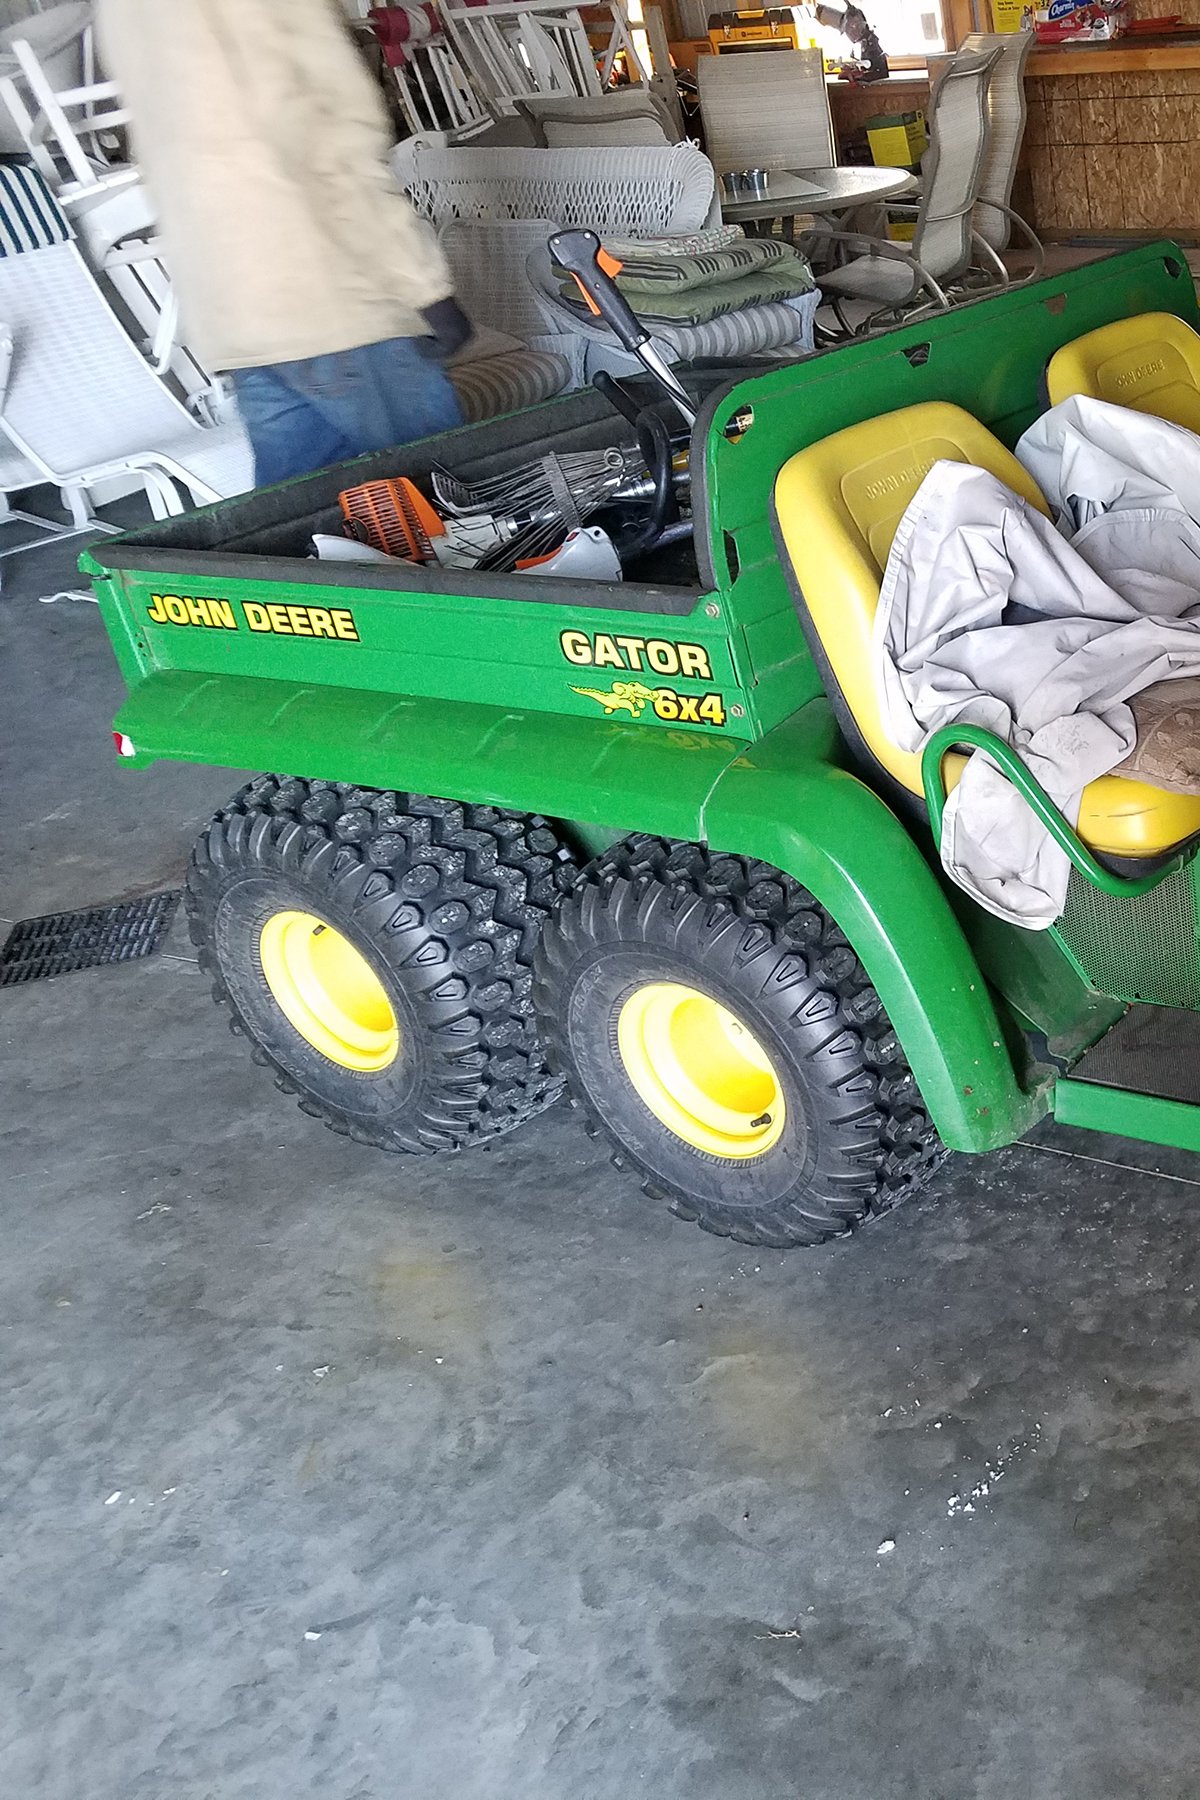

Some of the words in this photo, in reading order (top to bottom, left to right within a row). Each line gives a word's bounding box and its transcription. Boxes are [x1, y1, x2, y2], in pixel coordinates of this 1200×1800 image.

[865, 474, 899, 500] JOHN
[148, 594, 239, 630] JOHN
[241, 600, 361, 642] DEERE
[560, 629, 714, 681] GATOR
[653, 687, 727, 728] 6x4
